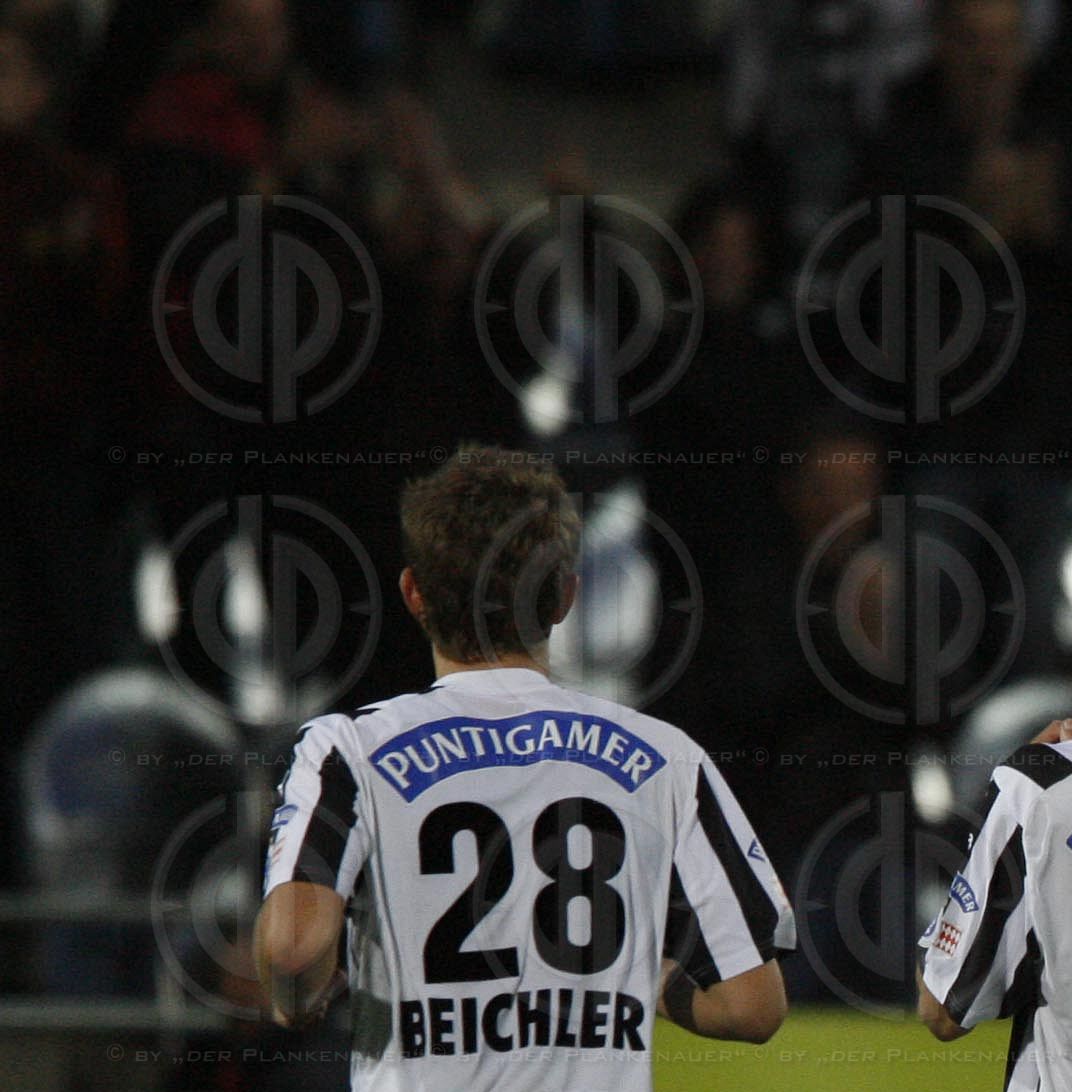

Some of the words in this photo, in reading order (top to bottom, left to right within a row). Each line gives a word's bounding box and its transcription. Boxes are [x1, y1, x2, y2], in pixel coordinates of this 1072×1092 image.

[376, 718, 653, 788] PUNTIGAMER
[418, 797, 627, 983] 28
[400, 988, 645, 1059] BEICHLER
